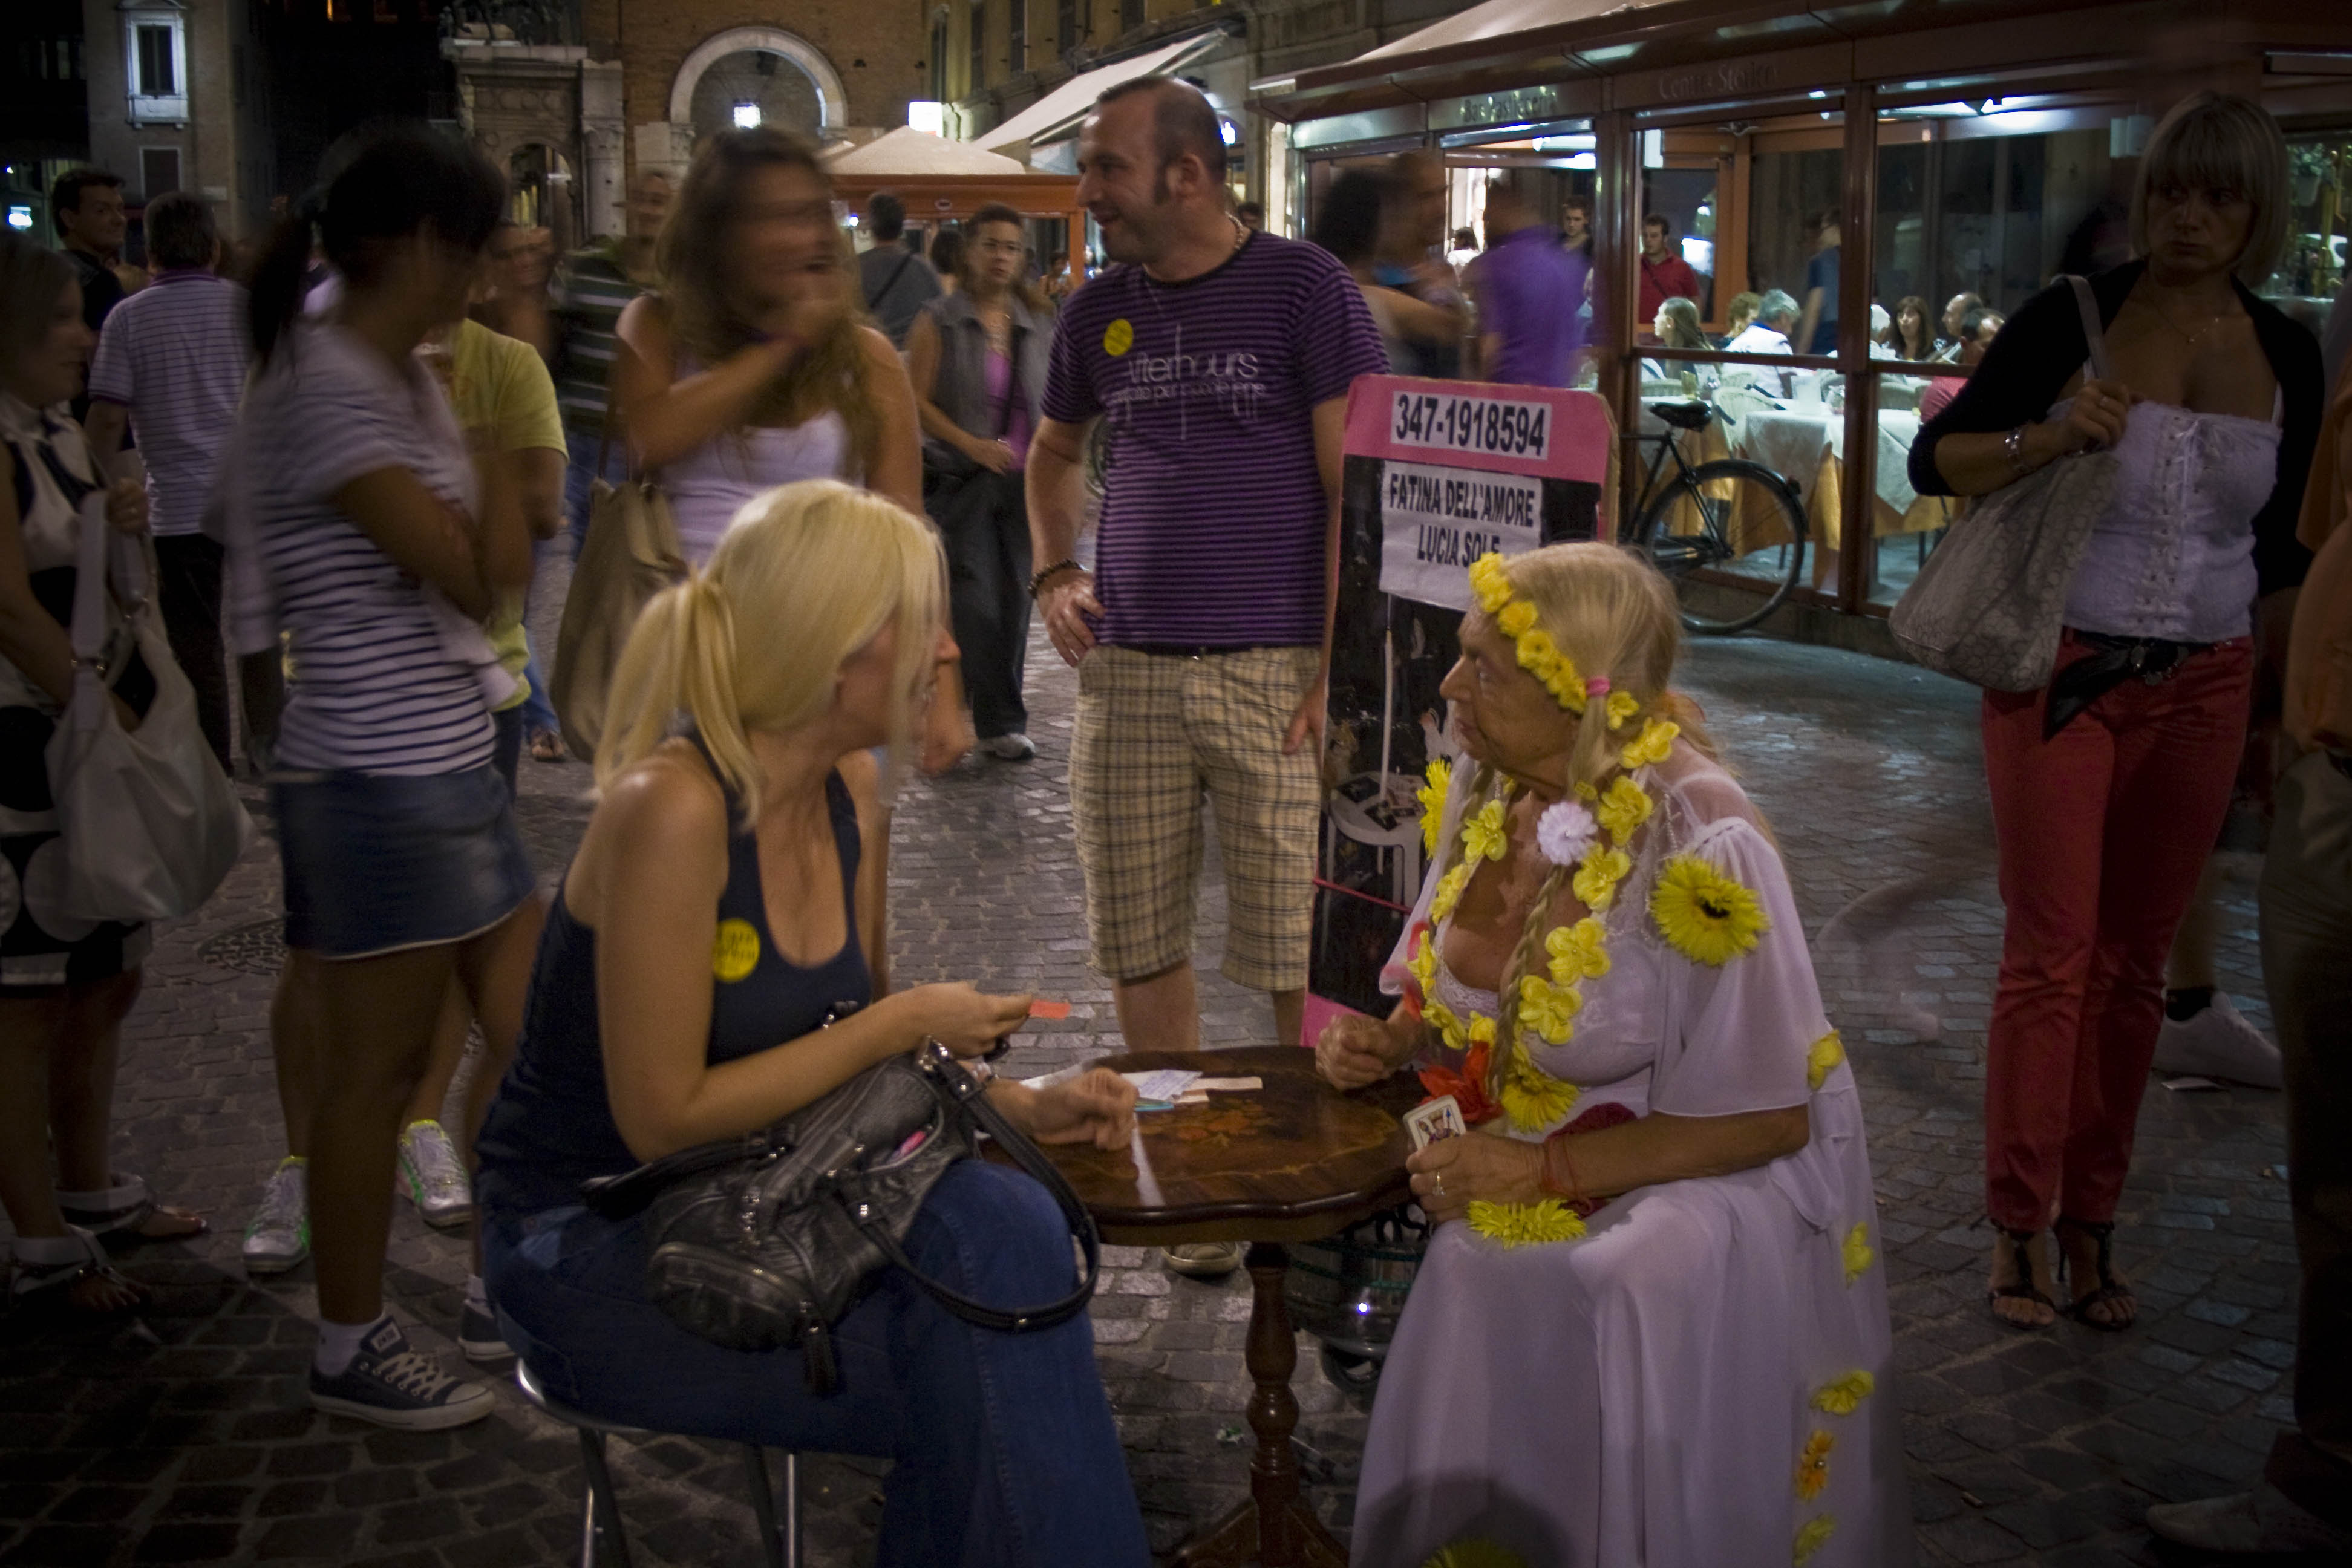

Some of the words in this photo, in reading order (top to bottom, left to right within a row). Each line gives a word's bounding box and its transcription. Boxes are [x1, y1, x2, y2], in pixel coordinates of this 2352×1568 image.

[1396, 394, 1545, 456] 347-1918594
[1390, 473, 1441, 514] FATINA
[1445, 479, 1535, 526] DELL'AMORE
[1418, 524, 1459, 566] LUCIA
